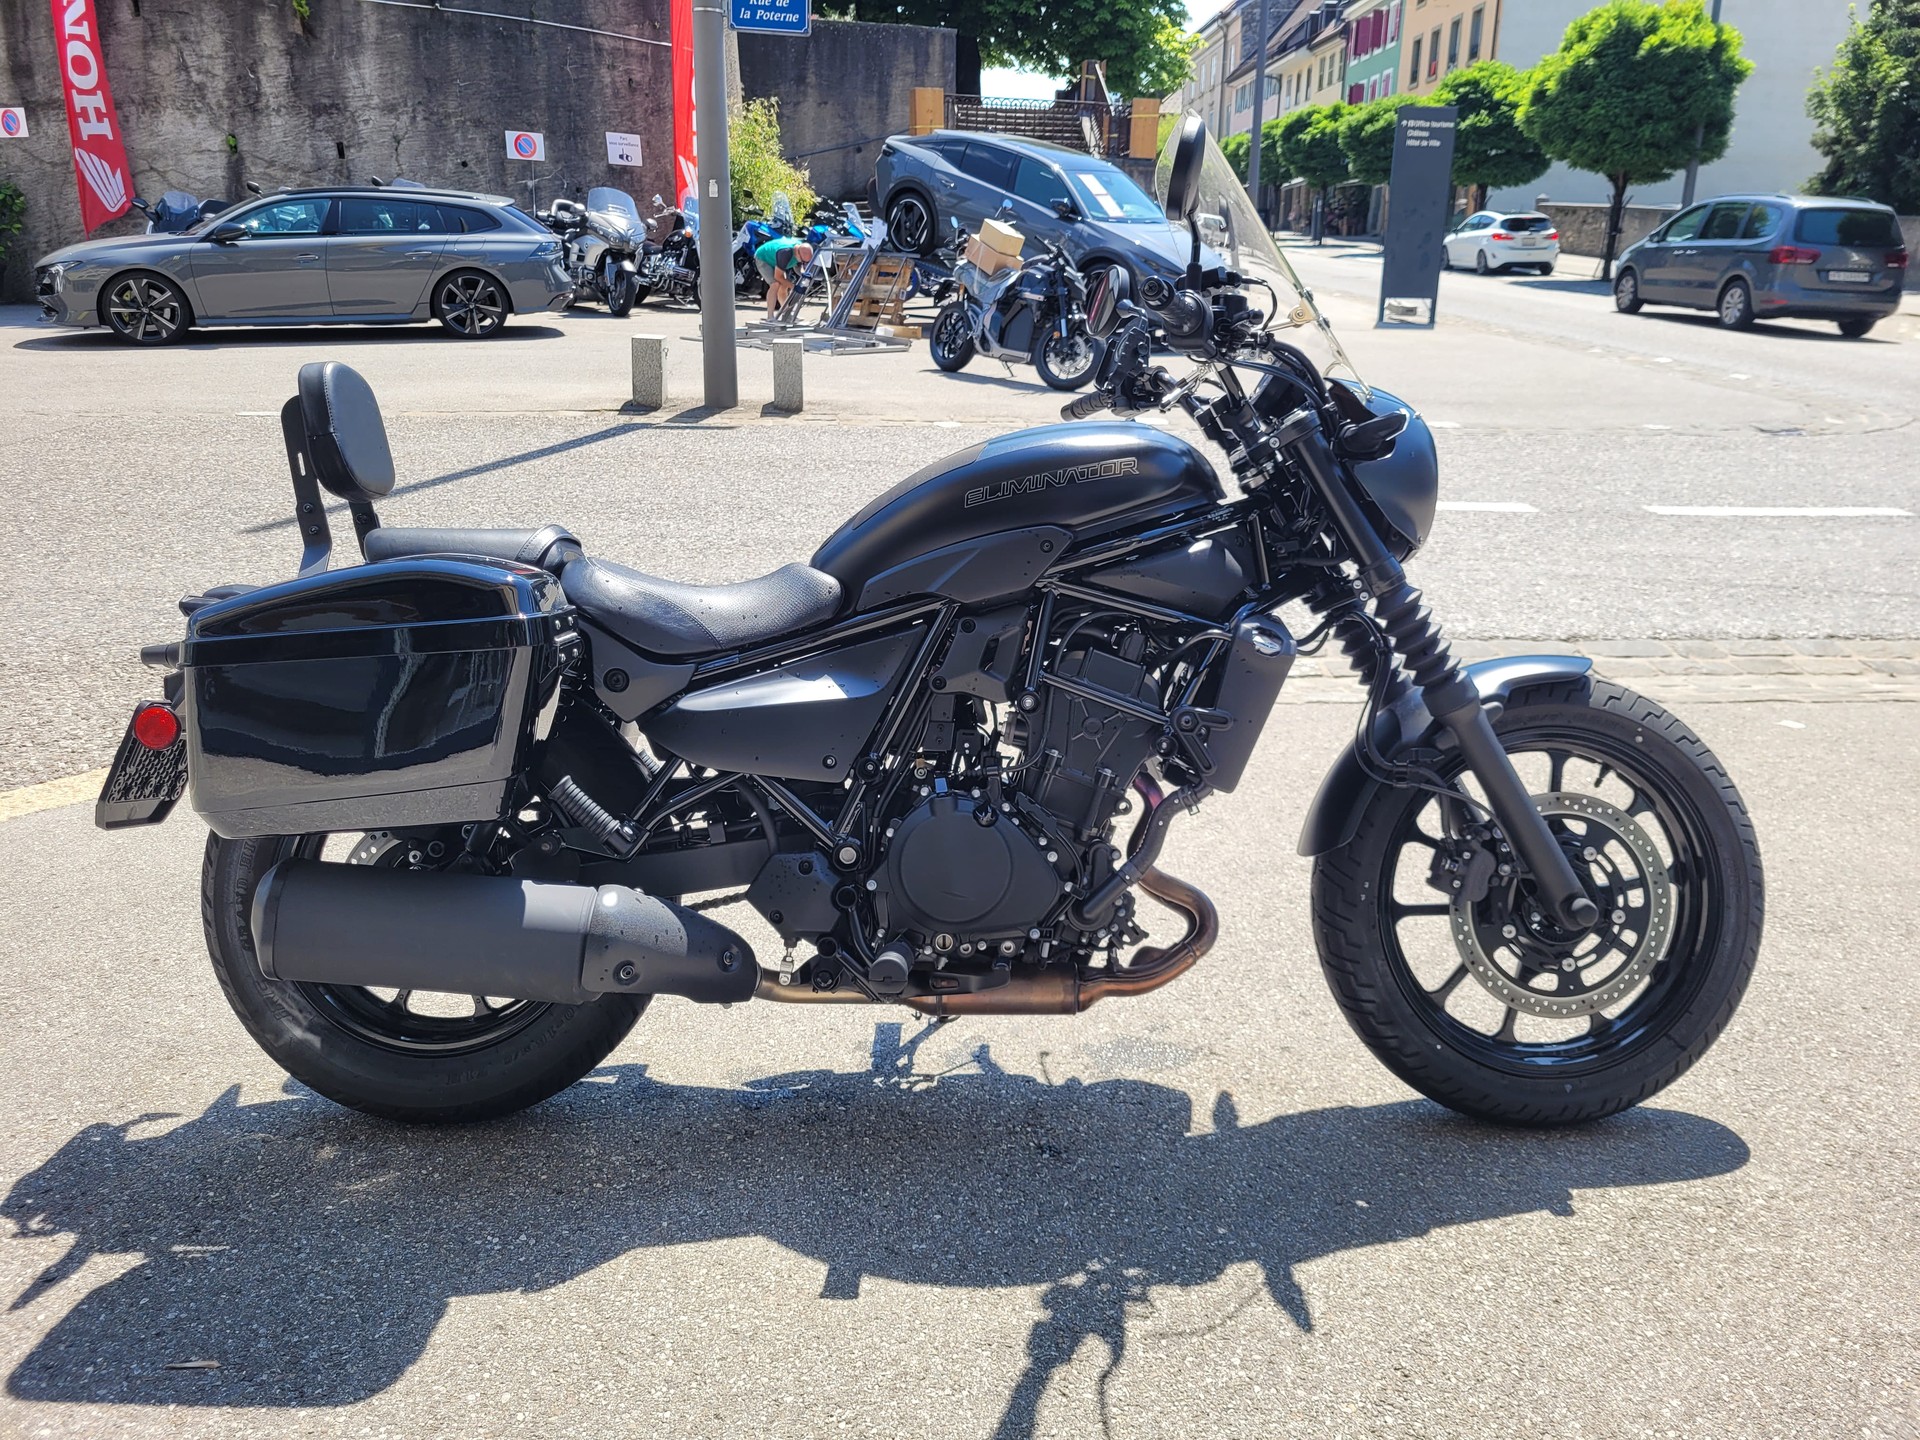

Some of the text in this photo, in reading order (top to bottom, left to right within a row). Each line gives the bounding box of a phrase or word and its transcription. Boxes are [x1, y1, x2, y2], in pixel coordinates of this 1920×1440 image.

[740, 7, 799, 22] la Poterne
[964, 456, 1140, 509] ELIMINATOR
